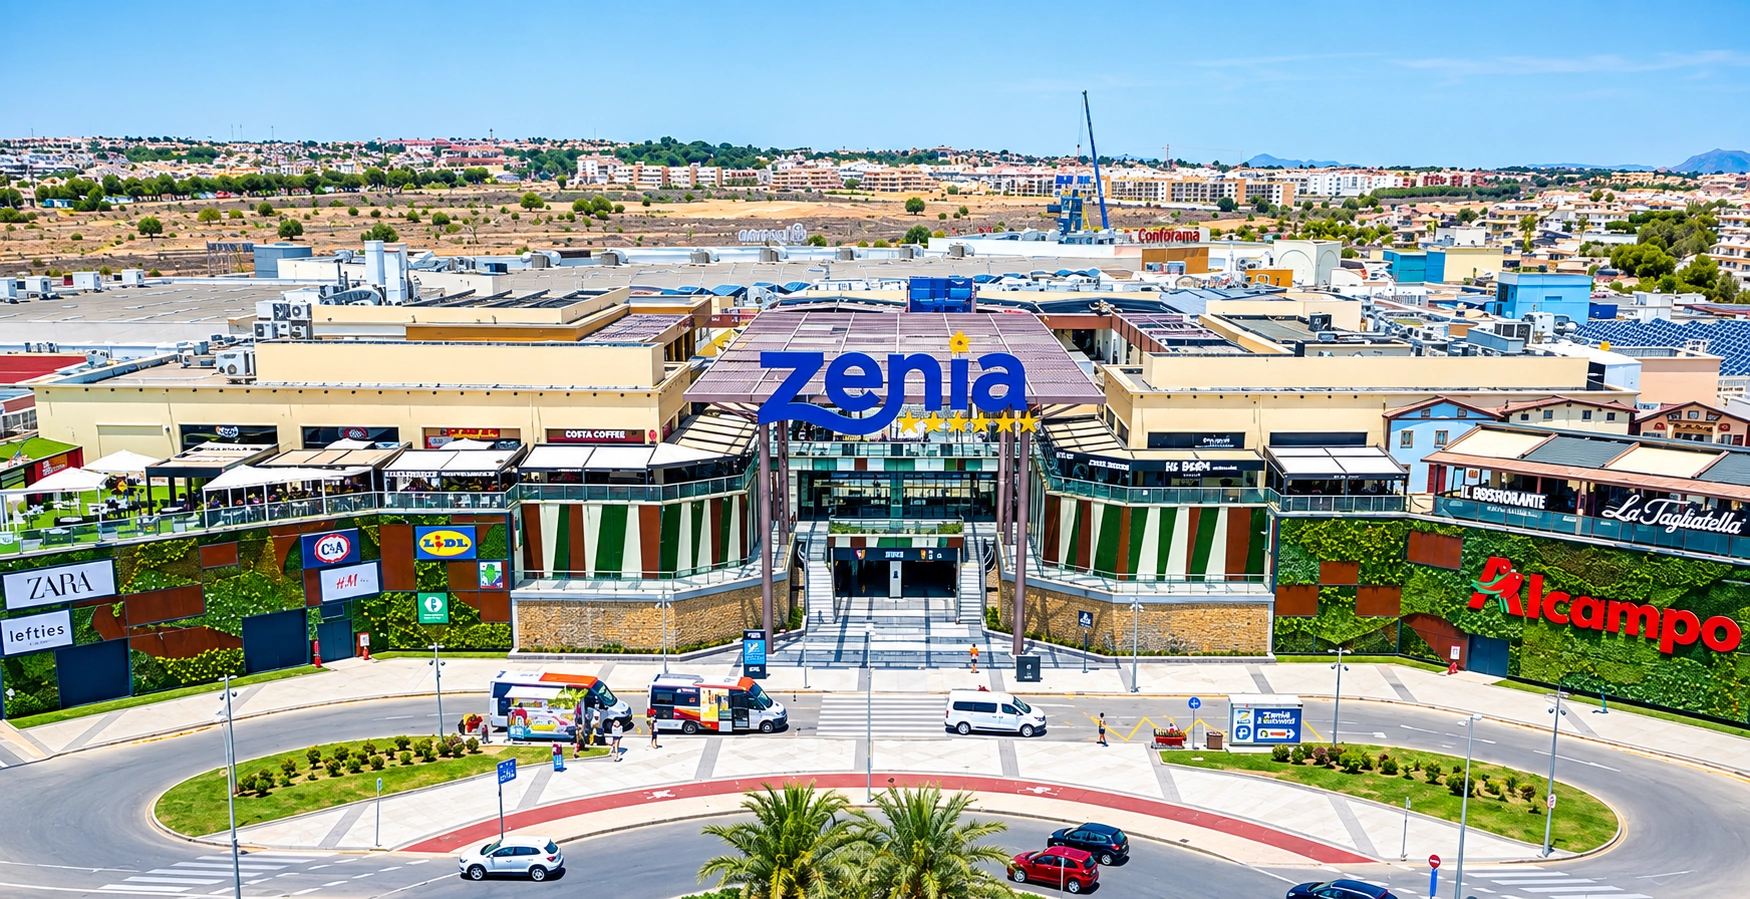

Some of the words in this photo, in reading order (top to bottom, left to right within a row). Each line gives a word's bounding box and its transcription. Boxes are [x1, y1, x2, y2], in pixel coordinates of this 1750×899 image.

[1138, 228, 1200, 243] Conforama
[565, 430, 592, 439] COSTA
[593, 430, 626, 439] COFFEE
[1601, 494, 1640, 523] La
[1639, 498, 1743, 535] Tagliatella
[321, 541, 344, 556] C&A
[27, 571, 94, 600] ZARA
[1468, 557, 1741, 654] Alcampo
[9, 624, 65, 643] lefties
